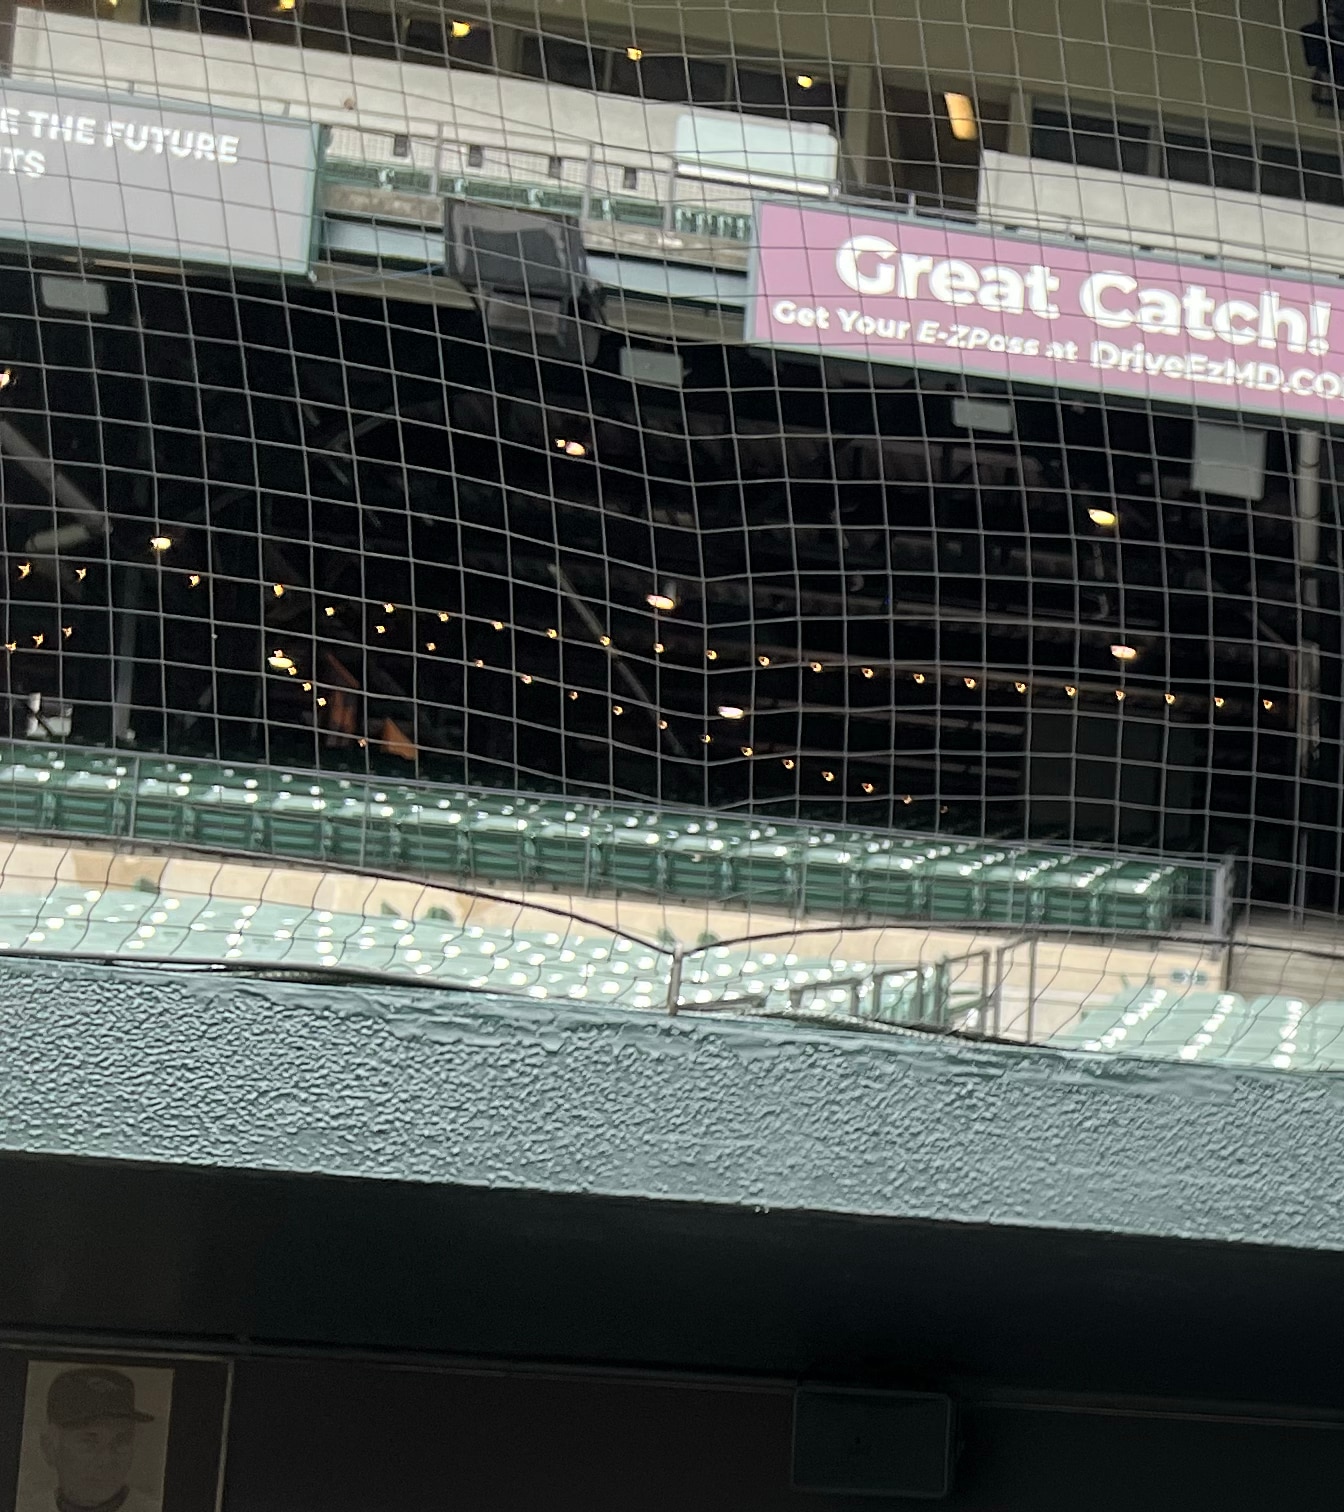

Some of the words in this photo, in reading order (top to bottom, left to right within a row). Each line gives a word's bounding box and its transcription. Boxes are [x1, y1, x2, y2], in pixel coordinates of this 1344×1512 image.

[28, 111, 96, 146] THE
[104, 120, 240, 164] FUTURE
[835, 235, 1060, 320] Great
[1079, 270, 1332, 357] Catch!
[772, 300, 829, 329] Get
[836, 307, 911, 340] Your
[916, 319, 1040, 356] E-ZPass
[1045, 340, 1079, 363] at
